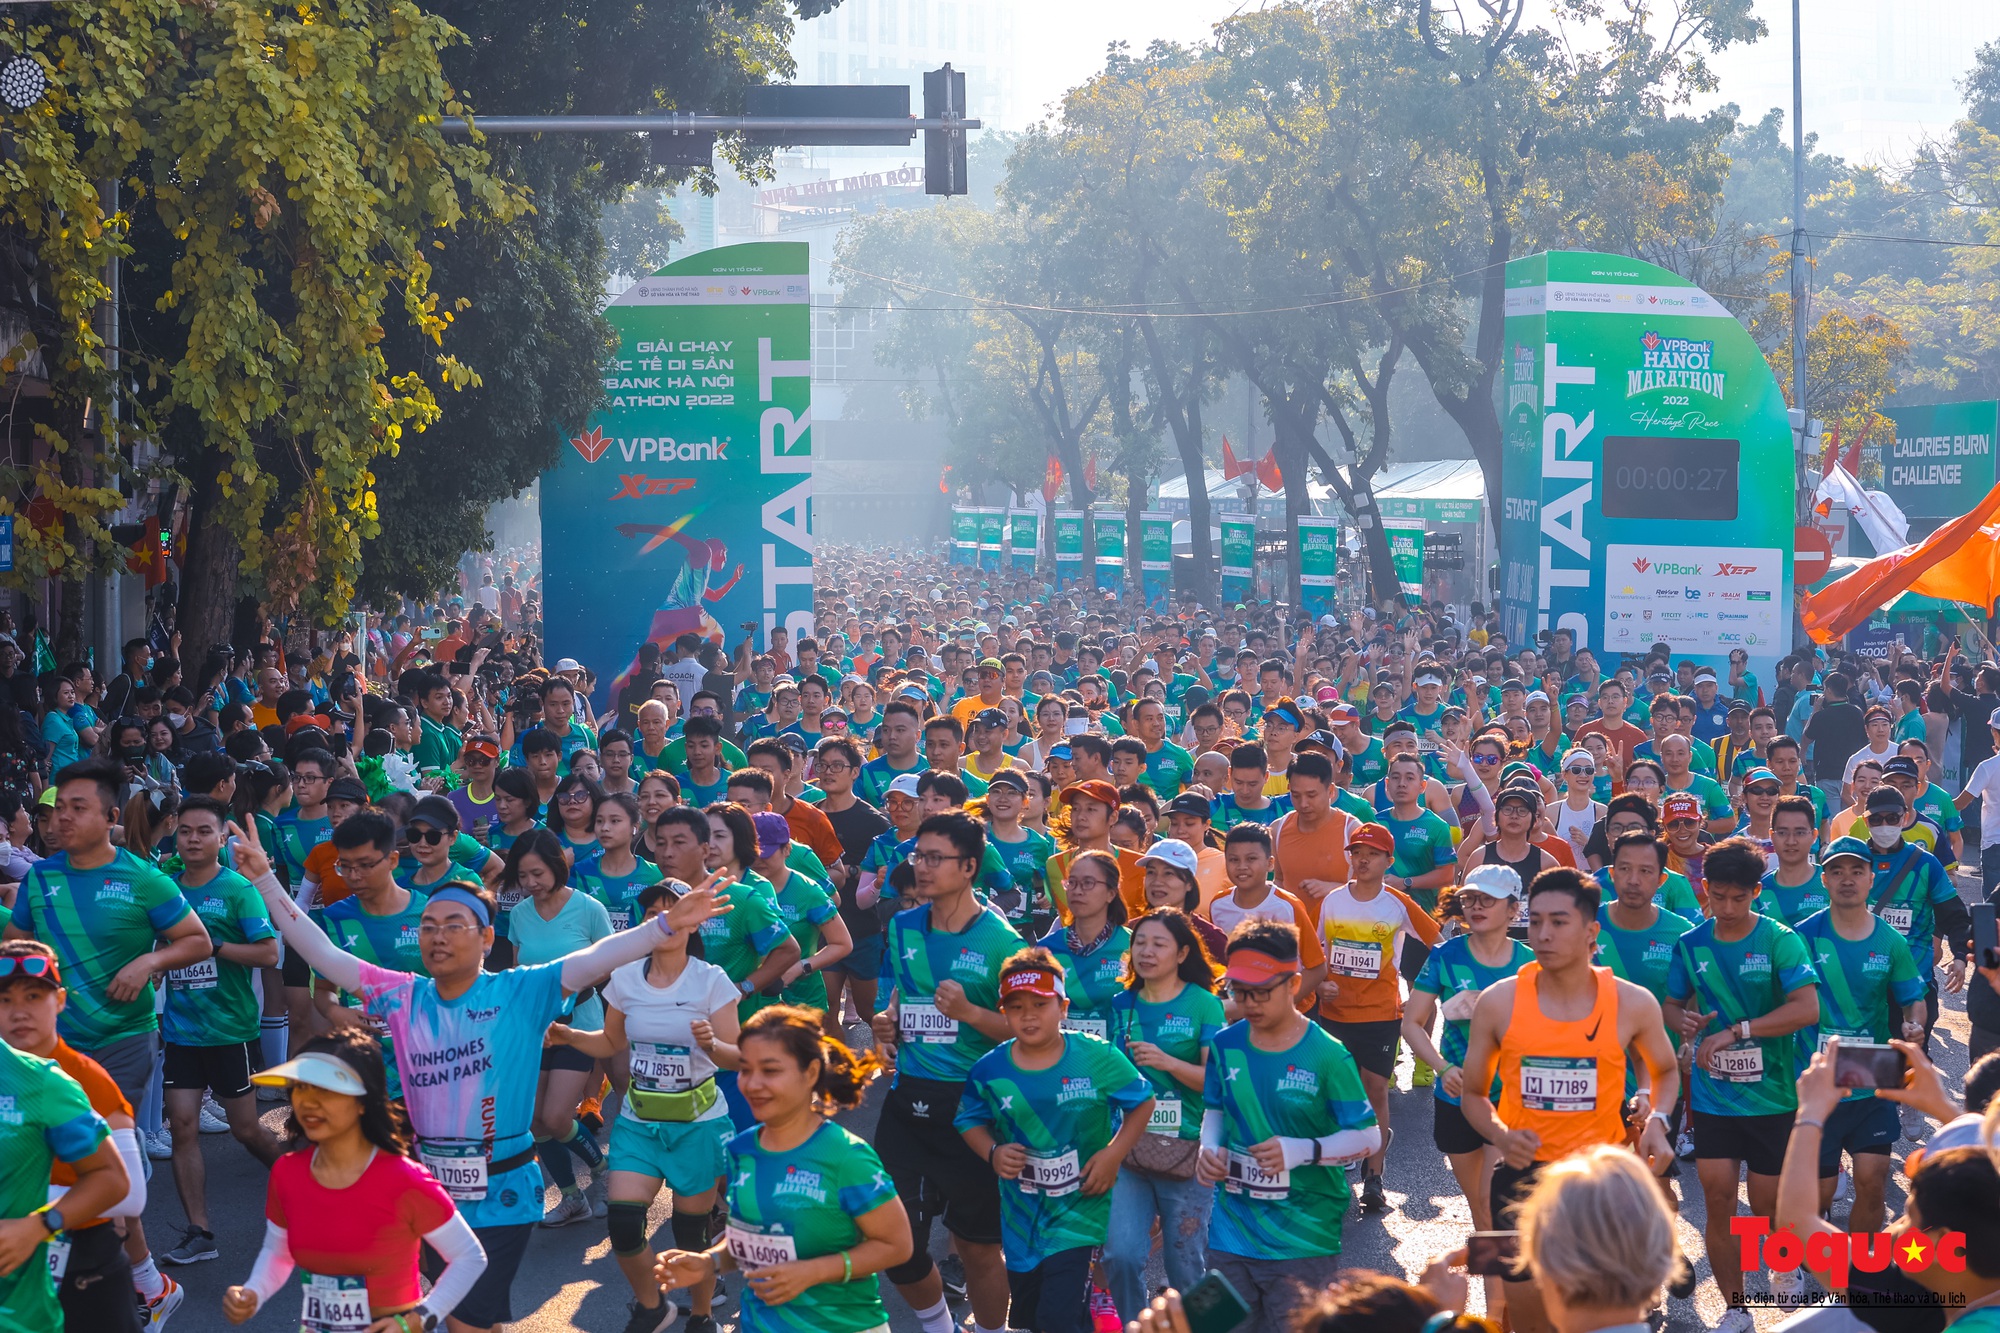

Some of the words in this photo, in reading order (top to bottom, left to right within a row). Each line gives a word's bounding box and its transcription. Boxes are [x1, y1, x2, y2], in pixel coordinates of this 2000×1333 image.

[1659, 298, 1685, 306] VPBank
[636, 339, 673, 353] GIẢI
[1662, 339, 1711, 353] VPBank
[639, 354, 662, 371] TẾ
[668, 359, 686, 371] DI
[692, 356, 734, 371] SẢN
[1643, 352, 1710, 370] HANOI
[604, 377, 661, 390] BANK
[667, 374, 696, 388] HÀ
[701, 374, 734, 390] NỘI
[1627, 370, 1725, 400] MARATHON
[613, 395, 680, 407] ATHON
[685, 394, 735, 407] 2022
[1662, 395, 1690, 406] 2022
[1630, 409, 1685, 432] Heritage
[1682, 411, 1720, 431] Race
[618, 436, 728, 462] VPBank
[1893, 436, 1951, 458] CALORIES
[1953, 434, 1989, 456] BURN
[1615, 466, 1728, 491] 00:00:27
[1892, 464, 1962, 486] CHALLENGE
[608, 473, 697, 500] XTEP
[1505, 497, 1538, 522] START
[1653, 561, 1703, 576] VPBank
[1712, 562, 1758, 577] XTEP
[1684, 586, 1701, 599] be
[1724, 633, 1741, 641] ACC
[668, 672, 695, 680] COACH
[1883, 914, 1907, 926] 13144
[1333, 952, 1345, 965] M
[1350, 955, 1374, 967] 11941
[184, 964, 213, 978] 16644
[1008, 972, 1041, 983] HANOI
[1011, 978, 1036, 986] 2022
[903, 1013, 916, 1029] M
[920, 1014, 951, 1029] 13108
[410, 1037, 485, 1068] VINHOMES
[408, 1067, 449, 1087] OCEAN
[453, 1054, 493, 1081] PARK
[633, 1058, 648, 1076] M
[652, 1061, 685, 1077] 18570
[1725, 1057, 1756, 1071] 12816
[1062, 1082, 1092, 1092] HANOI
[1525, 1076, 1542, 1094] M
[1549, 1079, 1588, 1095] 17189
[1056, 1088, 1098, 1106] MARATHON
[441, 1167, 480, 1184] 17059
[785, 1172, 820, 1187] HANOI
[1040, 1163, 1073, 1181] 19992
[772, 1182, 826, 1203] MARATHON
[730, 1241, 745, 1258] F
[749, 1245, 788, 1262] 16099
[308, 1297, 321, 1319] F
